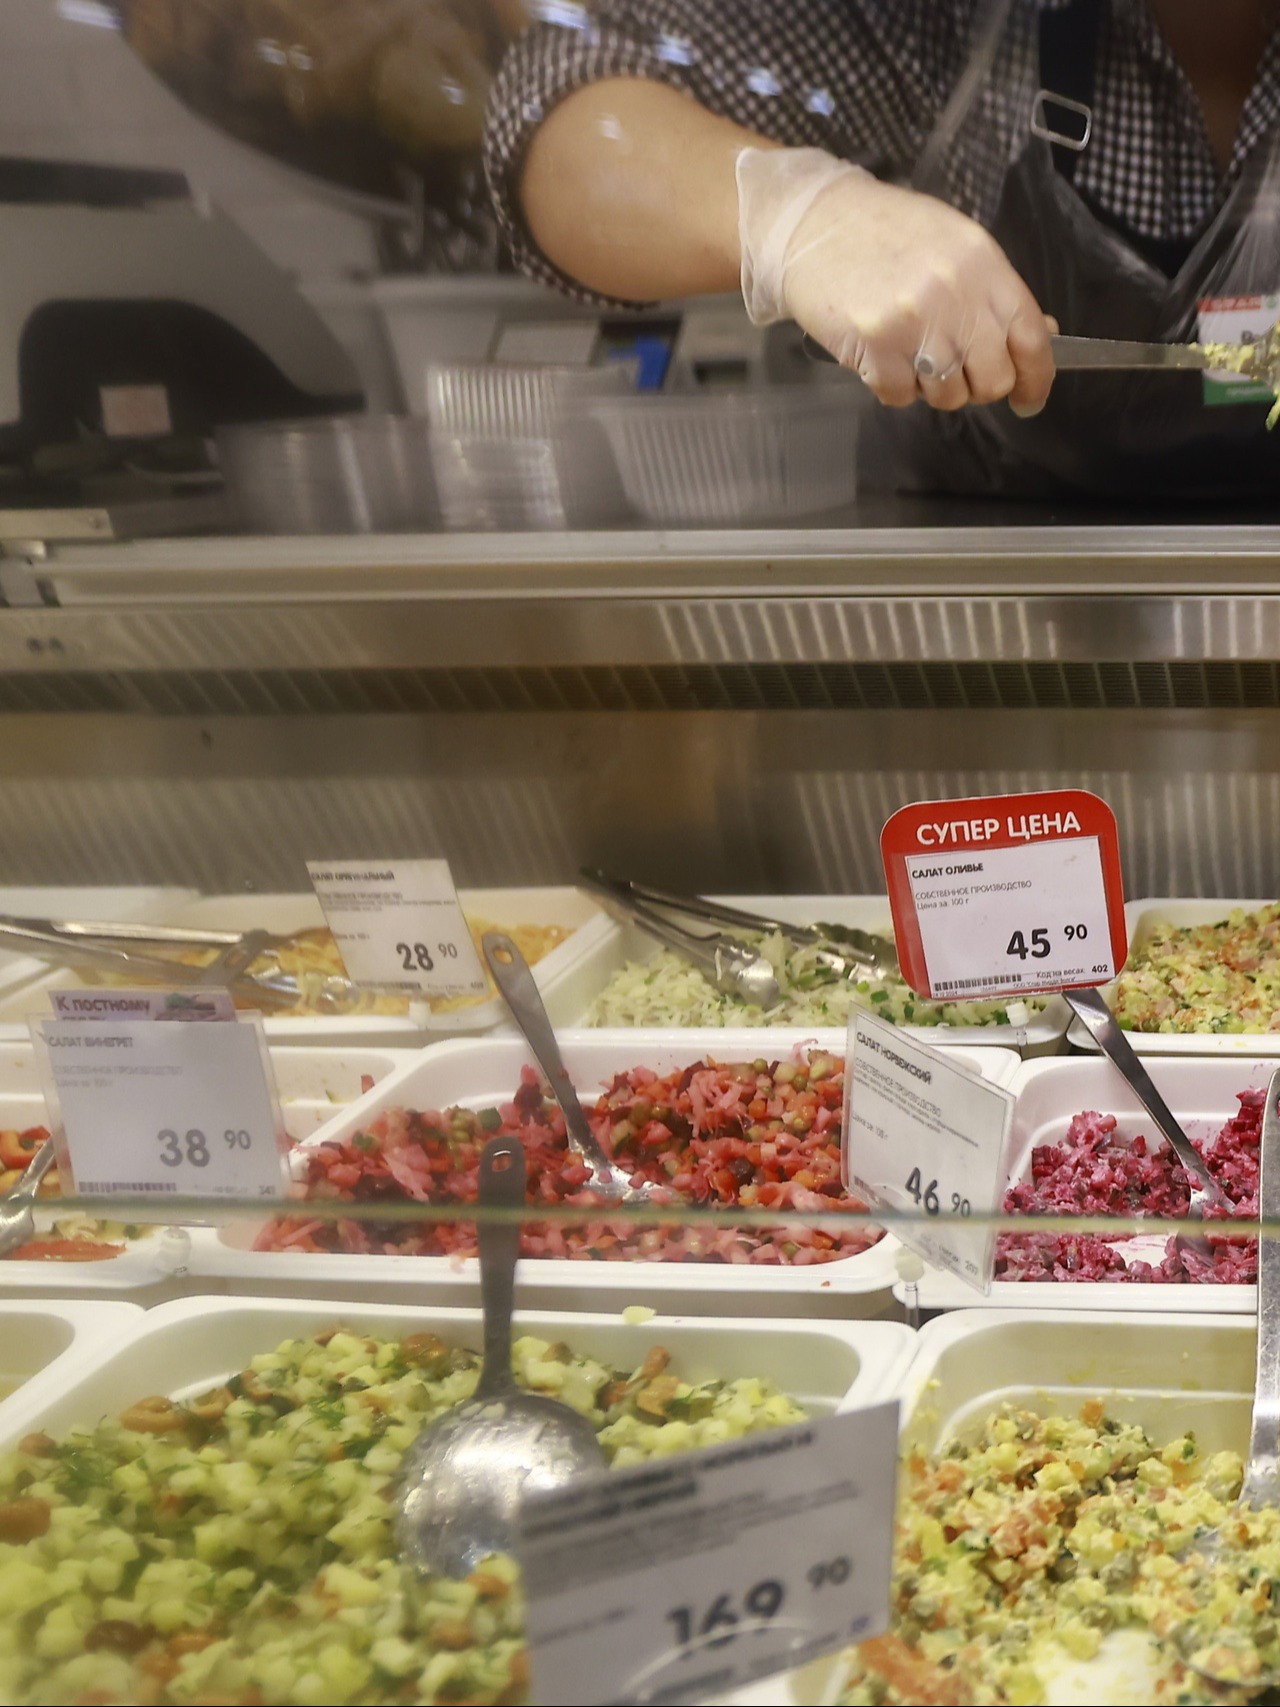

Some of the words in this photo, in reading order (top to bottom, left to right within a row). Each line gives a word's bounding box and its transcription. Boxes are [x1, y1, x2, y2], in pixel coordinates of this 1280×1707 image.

[916, 817, 1000, 846] СУПЕР
[1006, 810, 1081, 840] ЦЕНА
[911, 867, 943, 879] САЛАТ
[945, 863, 984, 875] ОЛИВЬЕ
[915, 886, 969, 900] СОБСТВЕННОЕ
[971, 880, 1033, 894] ПРОИЗВОДСТВО
[917, 900, 938, 911] Цена
[1006, 928, 1051, 960] 45
[1063, 923, 1088, 941] 90
[395, 942, 434, 971] 28
[437, 943, 458, 959] 90
[1036, 970, 1051, 979] Код
[1052, 969, 1062, 977] на
[1091, 964, 1108, 973] 402
[49, 1036, 82, 1048] САЛАТ
[857, 1031, 880, 1053] САЛАТ
[881, 1047, 932, 1085] НОРВЕЖСКИЙ
[157, 1128, 210, 1167] 38
[223, 1129, 251, 1150] 90
[905, 1167, 939, 1217] 46
[951, 1192, 971, 1218] 90
[806, 1556, 852, 1591] 90
[665, 1577, 786, 1661] 169
